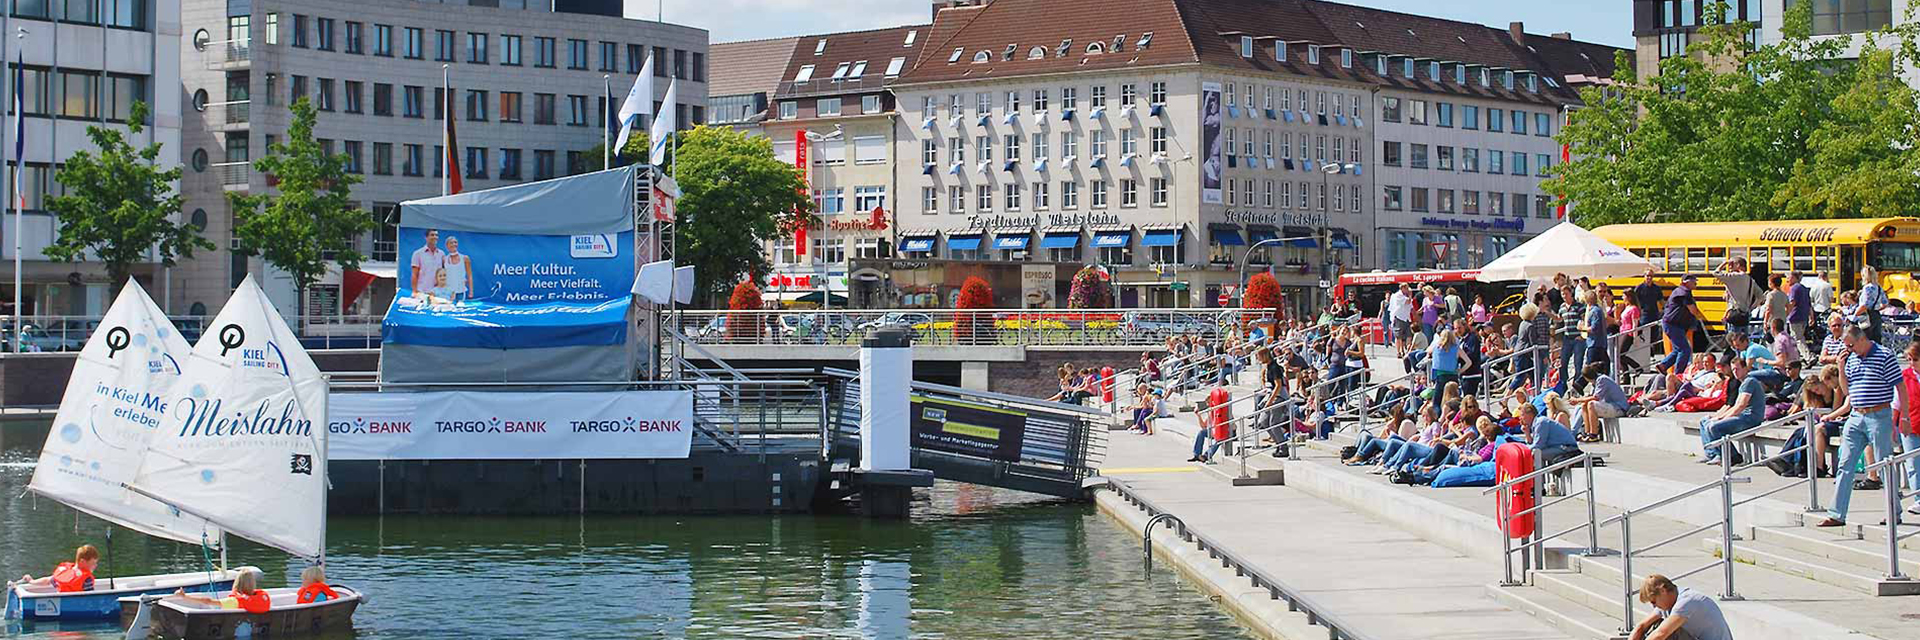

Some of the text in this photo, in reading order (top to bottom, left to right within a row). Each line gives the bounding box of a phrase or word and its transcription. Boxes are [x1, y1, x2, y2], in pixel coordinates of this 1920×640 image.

[967, 211, 1119, 231] Ferdinand Meislahn
[1225, 208, 1277, 224] Ferdinand
[575, 236, 593, 245] KIEL
[1760, 227, 1838, 242] SCHOOL CAFE
[493, 263, 577, 276] Meer Kultur.
[1024, 271, 1052, 279] ESPRESSO
[530, 279, 602, 289] Meer Vielfalt.
[770, 272, 792, 286] alte
[794, 274, 811, 287] rat
[506, 291, 608, 301] Meer Erlebnis.
[243, 348, 265, 360] KIEL
[267, 361, 279, 369] CITY
[96, 381, 109, 395] in
[112, 386, 139, 404] Kiel
[175, 397, 312, 437] Meislahn
[369, 421, 412, 434] BANK
[434, 421, 547, 433] TARGO BANK
[570, 420, 682, 433] TARGO BANK
